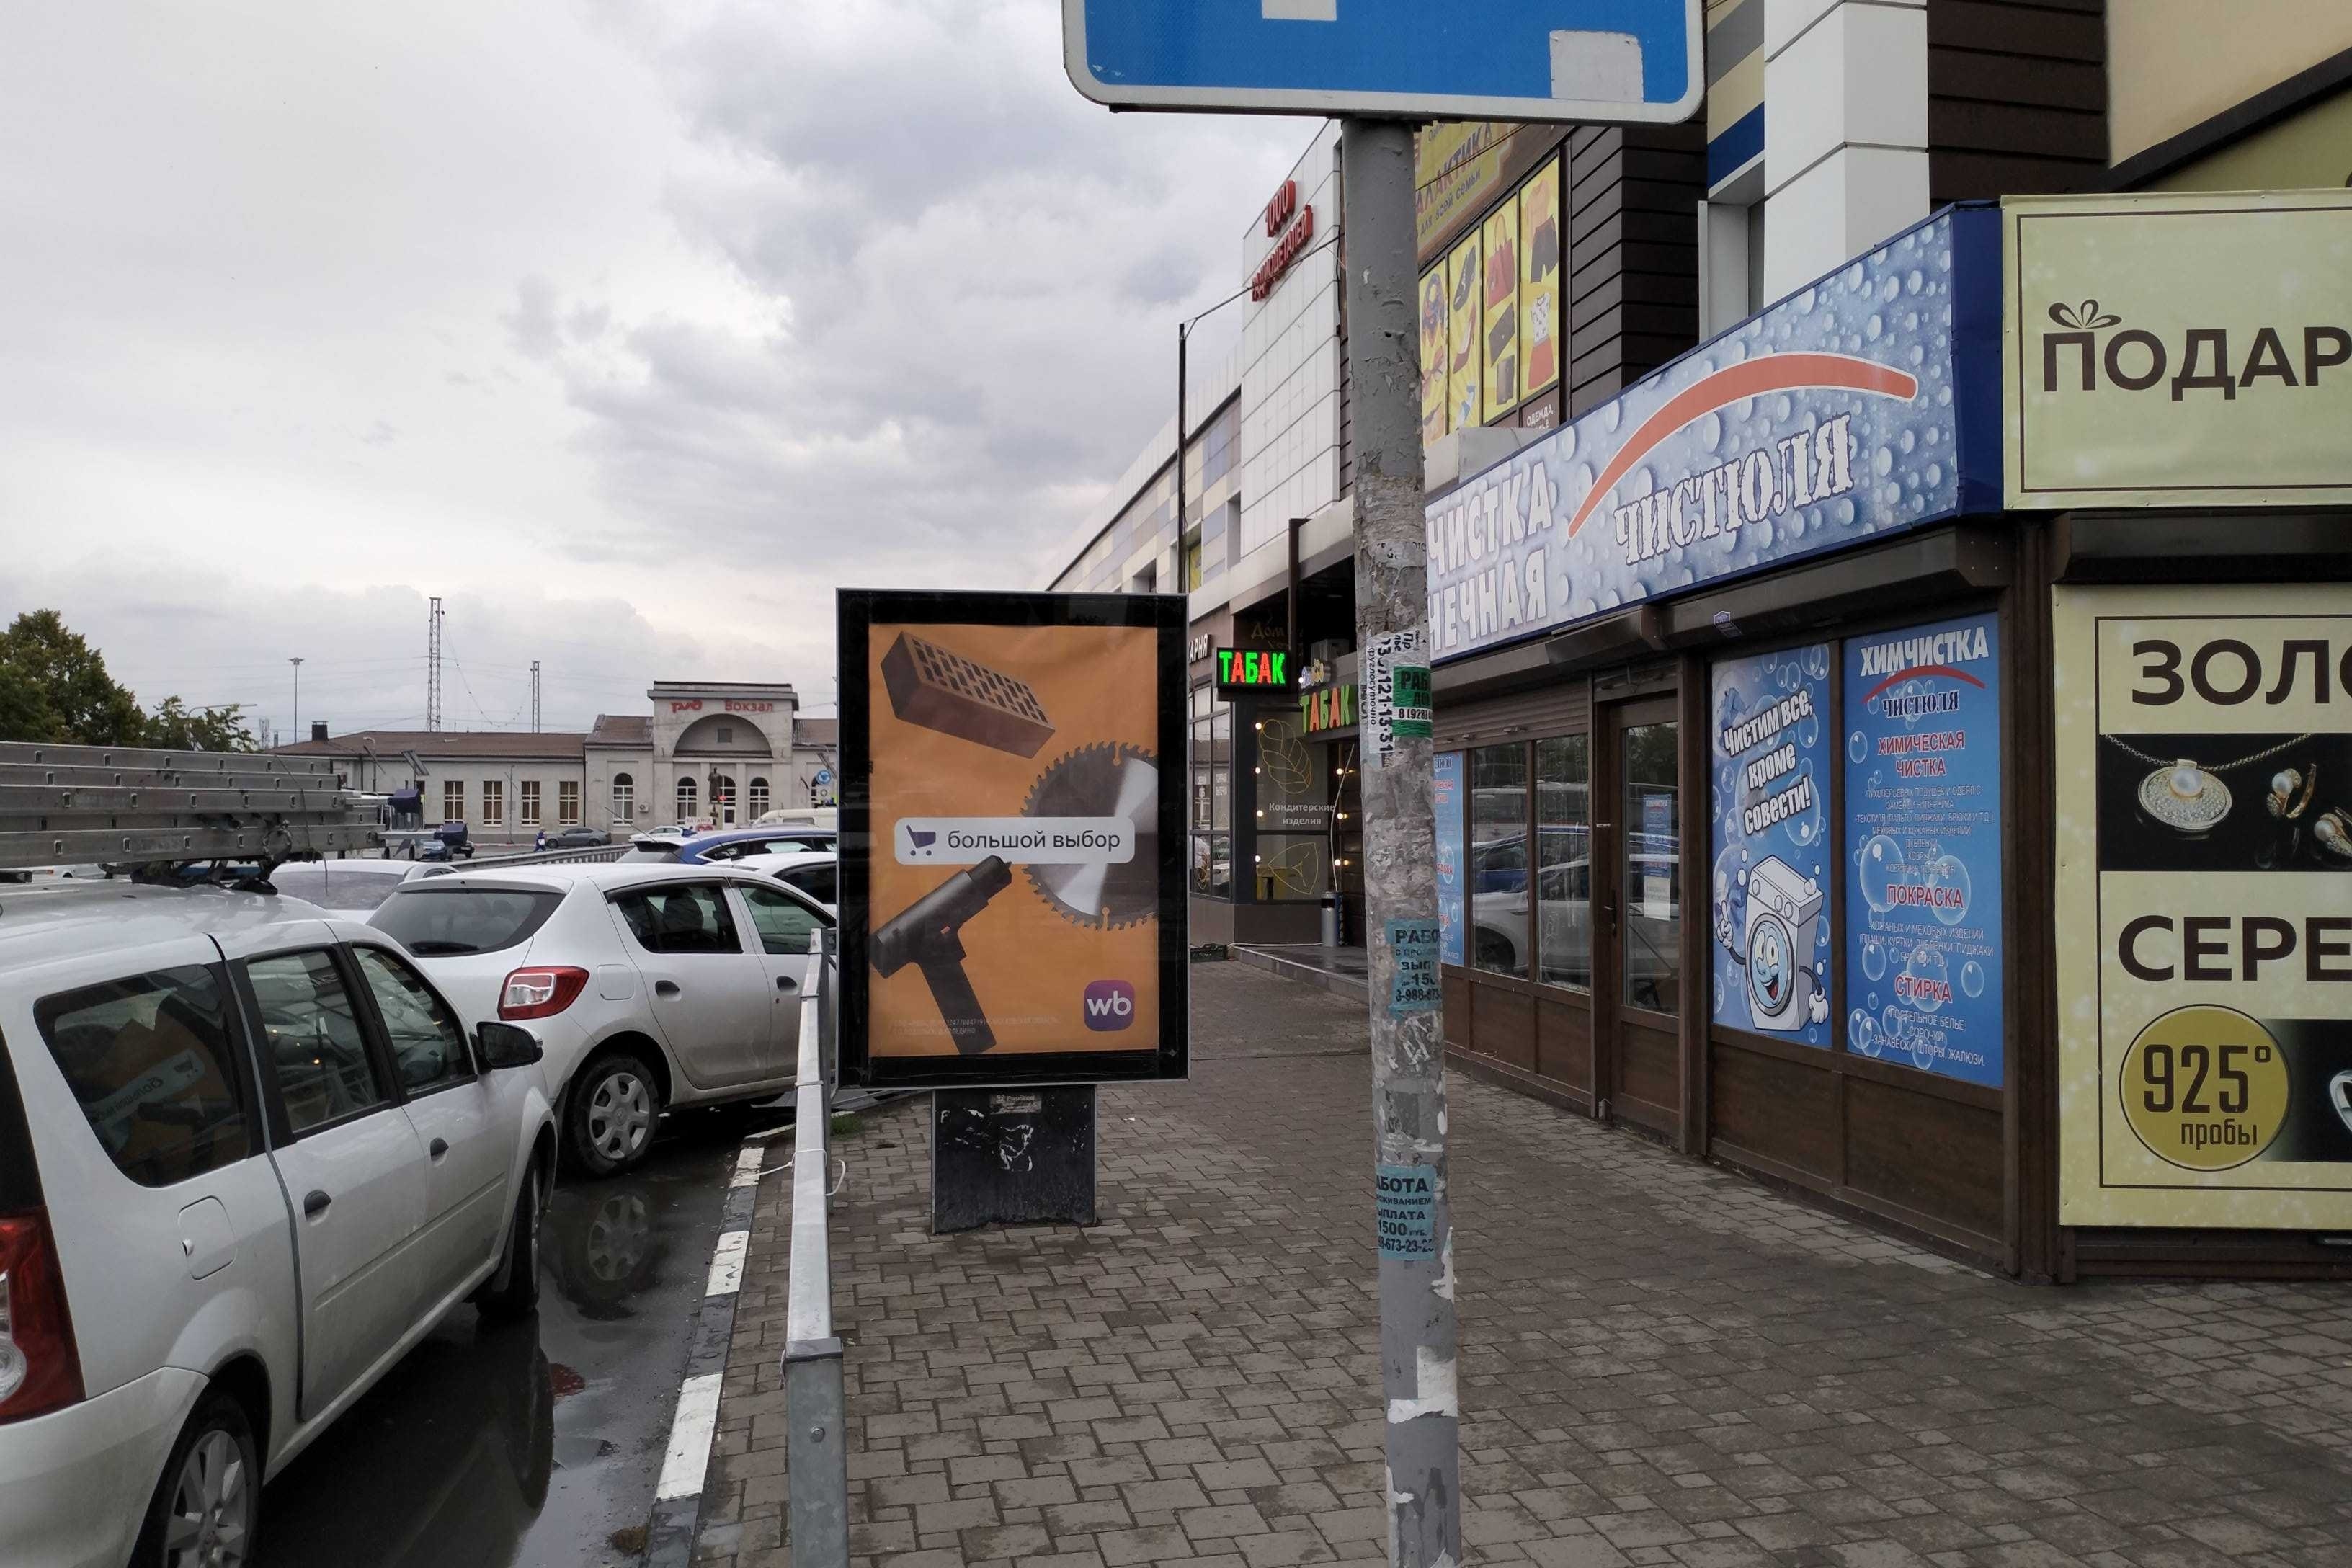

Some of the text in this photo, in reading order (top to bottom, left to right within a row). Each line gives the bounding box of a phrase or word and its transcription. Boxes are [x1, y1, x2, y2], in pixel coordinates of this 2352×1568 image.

[2042, 326, 2352, 401] ПОДАР
[1613, 411, 1855, 566] ЧИСТЮЛЯ
[1427, 461, 1553, 576] ЧИСТКА
[1219, 651, 1286, 685] ТАБАК
[1861, 627, 1989, 677] ХИМЧИСТКА
[2131, 639, 2352, 705] ЗОЛ
[1300, 684, 1351, 734] ТАБАК
[1882, 690, 1960, 719] ЧИСТЮЛЯ
[1723, 690, 1814, 756] Чистим все,
[1878, 731, 1965, 755] ХИМИЧЕСКАЯ
[1747, 743, 1796, 789] кроме
[1896, 757, 1946, 778] ЧИСТКА
[1268, 802, 1335, 813] Кондитерские
[1744, 776, 1812, 834] совести!
[1283, 818, 1322, 827] изделия
[948, 829, 1121, 852] большой выбор
[1886, 883, 1964, 909] ПОКРАСКА
[1086, 990, 1132, 1017] wb
[1894, 976, 1953, 1003] СТИРКА
[2180, 1117, 2258, 1152] пробы
